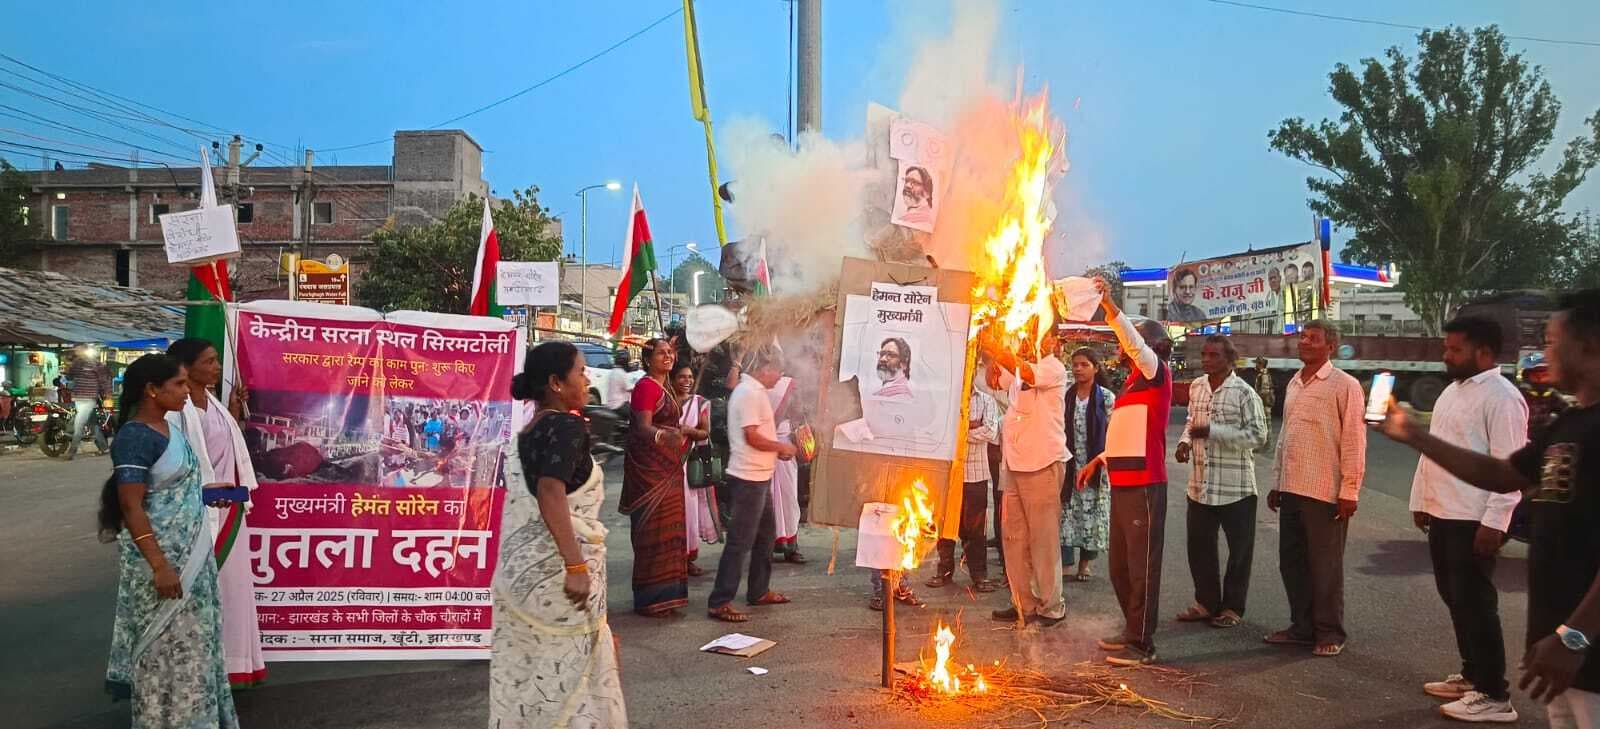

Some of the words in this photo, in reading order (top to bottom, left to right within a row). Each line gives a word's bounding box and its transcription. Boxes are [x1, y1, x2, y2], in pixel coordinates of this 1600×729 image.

[872, 288, 901, 303] हेमन्त
[903, 290, 932, 305] सोरेन
[877, 308, 923, 323] मुख्यमंत्री
[249, 314, 317, 342] केन्द्रीय
[321, 326, 371, 345] सरना
[375, 329, 418, 350] स्थल
[422, 329, 510, 354] सिरमटोली
[282, 352, 320, 366] सरकार
[322, 354, 344, 369] द्वारा
[346, 352, 365, 367] रैम्प
[368, 357, 384, 368] का
[385, 358, 408, 370] काम
[431, 361, 451, 376] शुरू
[454, 360, 476, 376] किए
[346, 372, 370, 389] जाने
[388, 374, 415, 390] लेकर
[274, 493, 347, 519] मुख्यमंत्री
[351, 492, 391, 517] हेमंत
[396, 493, 440, 517] सोरेन
[443, 499, 465, 516] का
[249, 527, 379, 585] पुतला
[391, 529, 493, 579] दहन
[271, 591, 286, 602] 27
[316, 591, 344, 602] 2025
[347, 588, 384, 604] (रविवार)
[424, 592, 443, 602] शाम
[445, 591, 473, 602] 04:00
[475, 589, 491, 602] बजे
[287, 610, 330, 625] झारखंड
[332, 609, 344, 623] के
[346, 608, 370, 623] सभी
[372, 608, 400, 623] जिलों
[401, 608, 412, 623] के
[472, 608, 483, 623] में
[309, 634, 342, 644] सरना
[345, 634, 387, 645] समाज,
[426, 633, 483, 645] झारखण्ड
